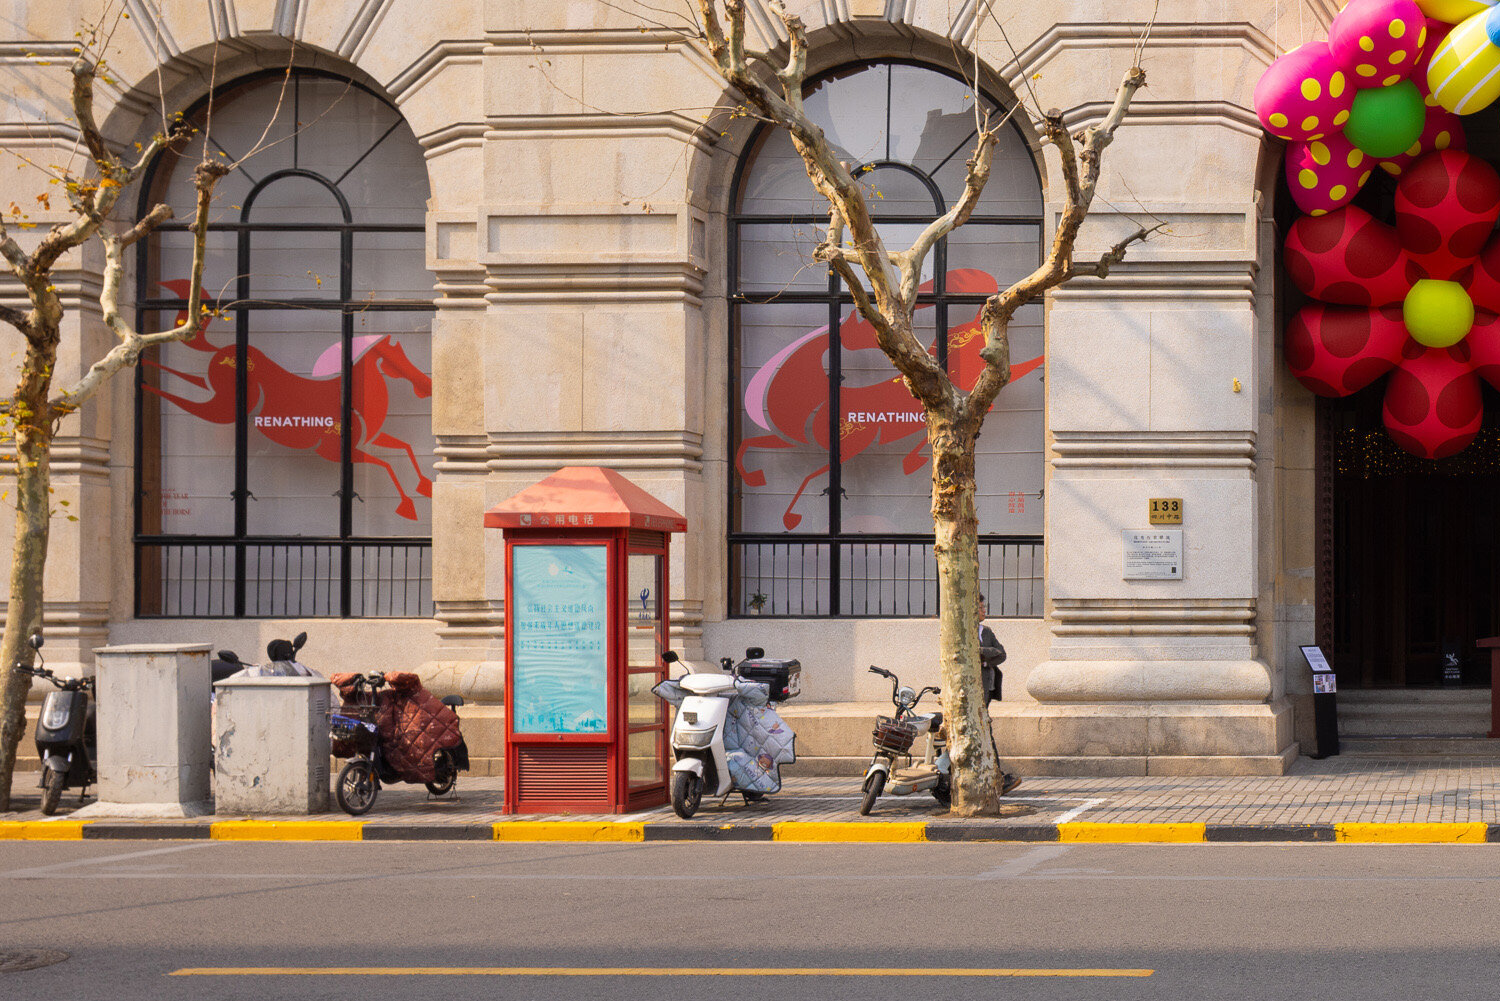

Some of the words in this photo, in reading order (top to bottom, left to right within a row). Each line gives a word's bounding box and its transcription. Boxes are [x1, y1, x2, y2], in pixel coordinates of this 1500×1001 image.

[254, 416, 334, 427] RENATHING
[1153, 501, 1179, 511] 133
[540, 514, 594, 525] 公用电话
